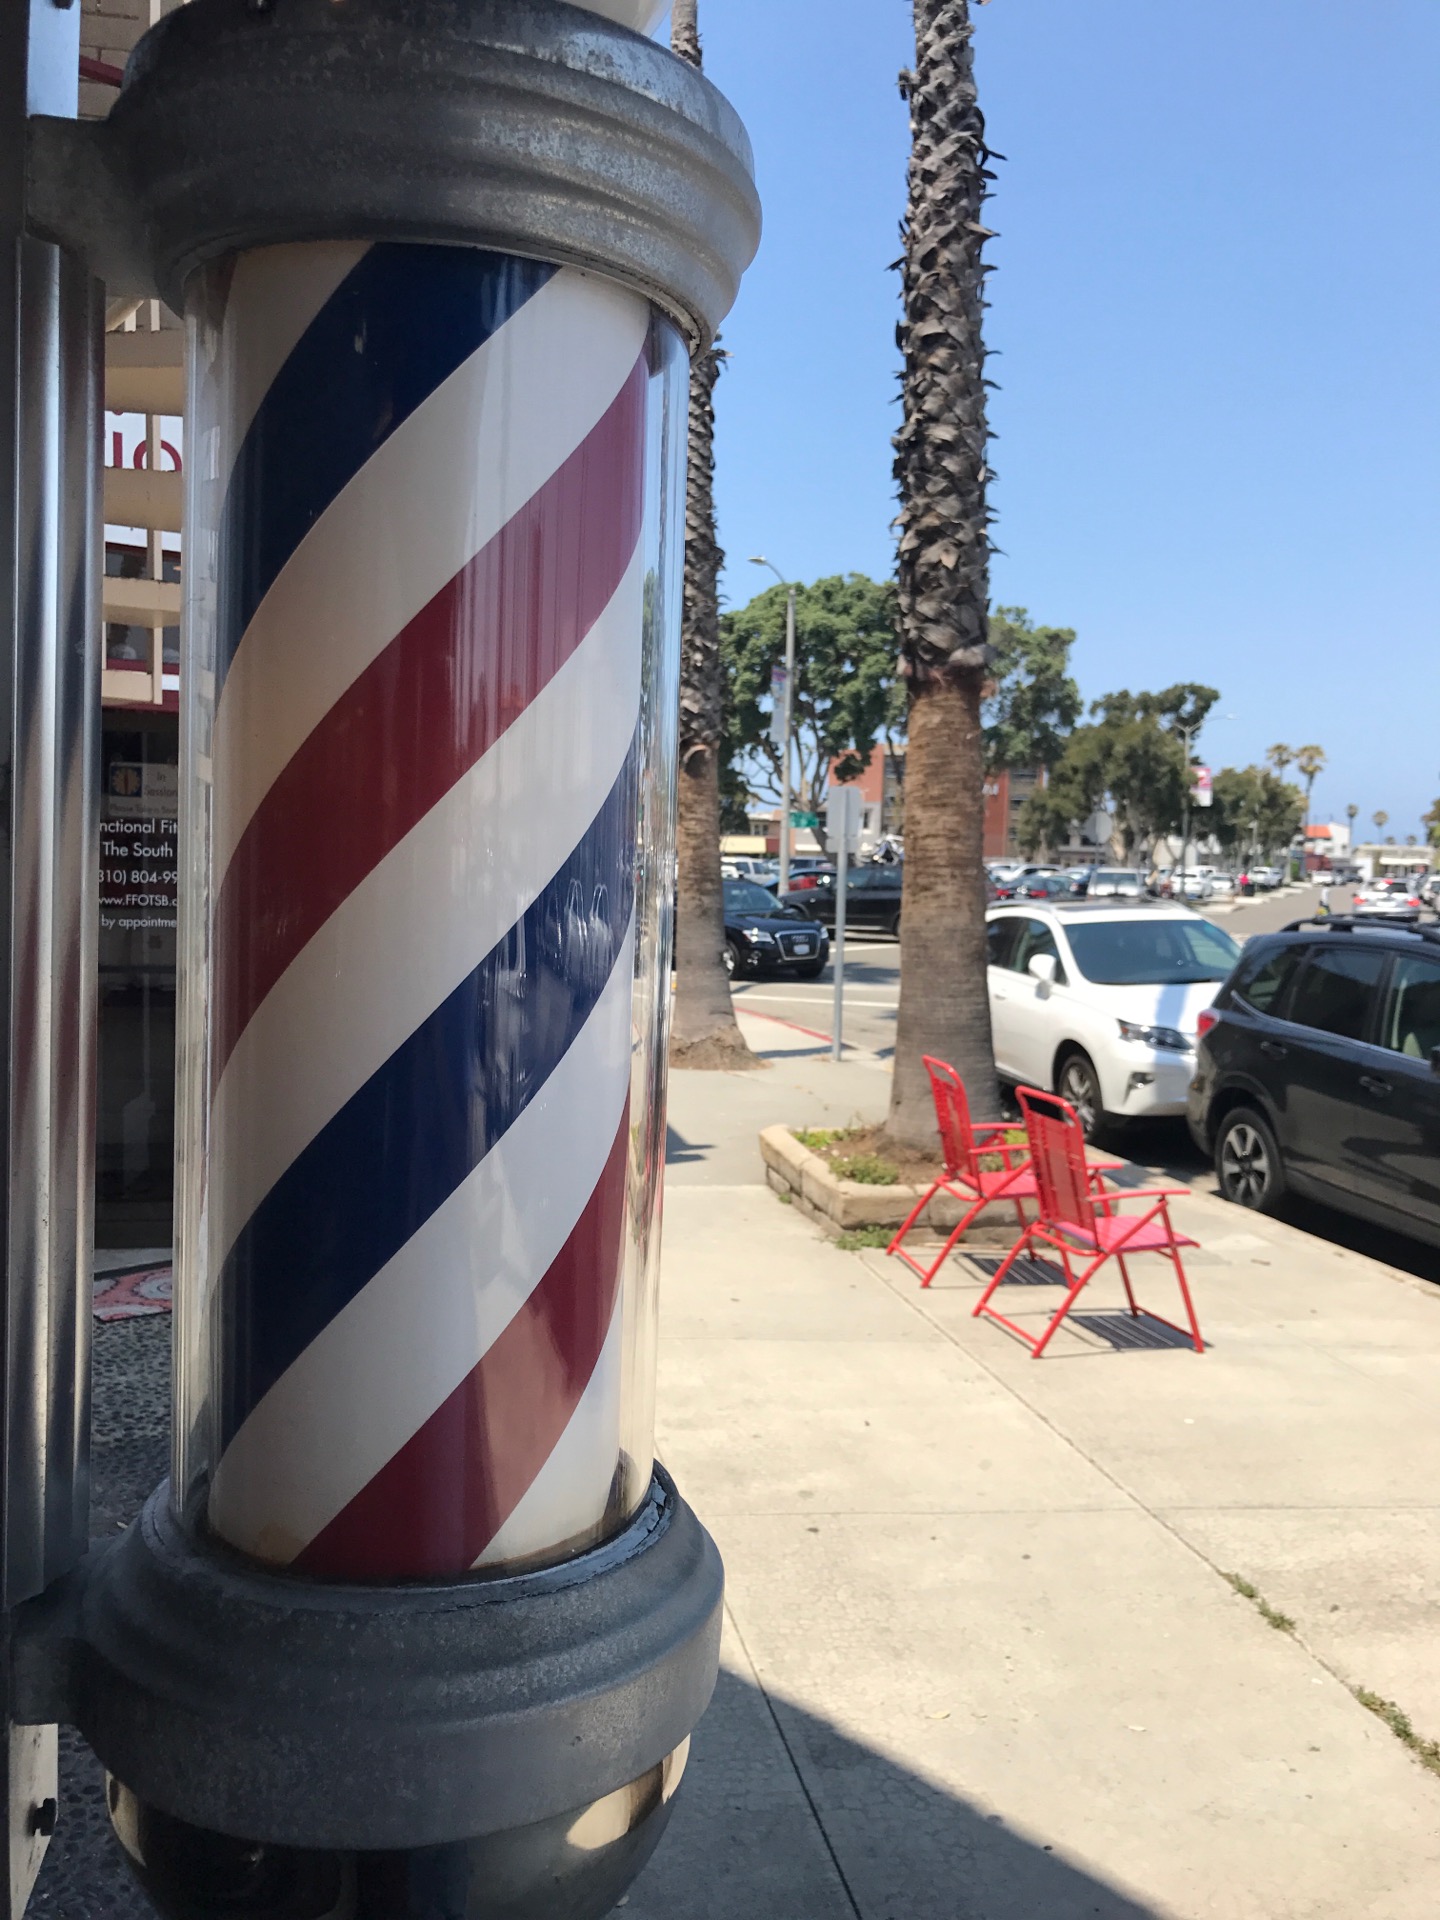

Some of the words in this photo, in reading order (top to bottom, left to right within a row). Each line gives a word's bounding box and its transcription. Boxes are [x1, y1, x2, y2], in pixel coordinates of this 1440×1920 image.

[99, 818, 155, 834] nctional
[103, 840, 129, 857] The
[133, 841, 173, 858] South
[101, 913, 116, 930] by
